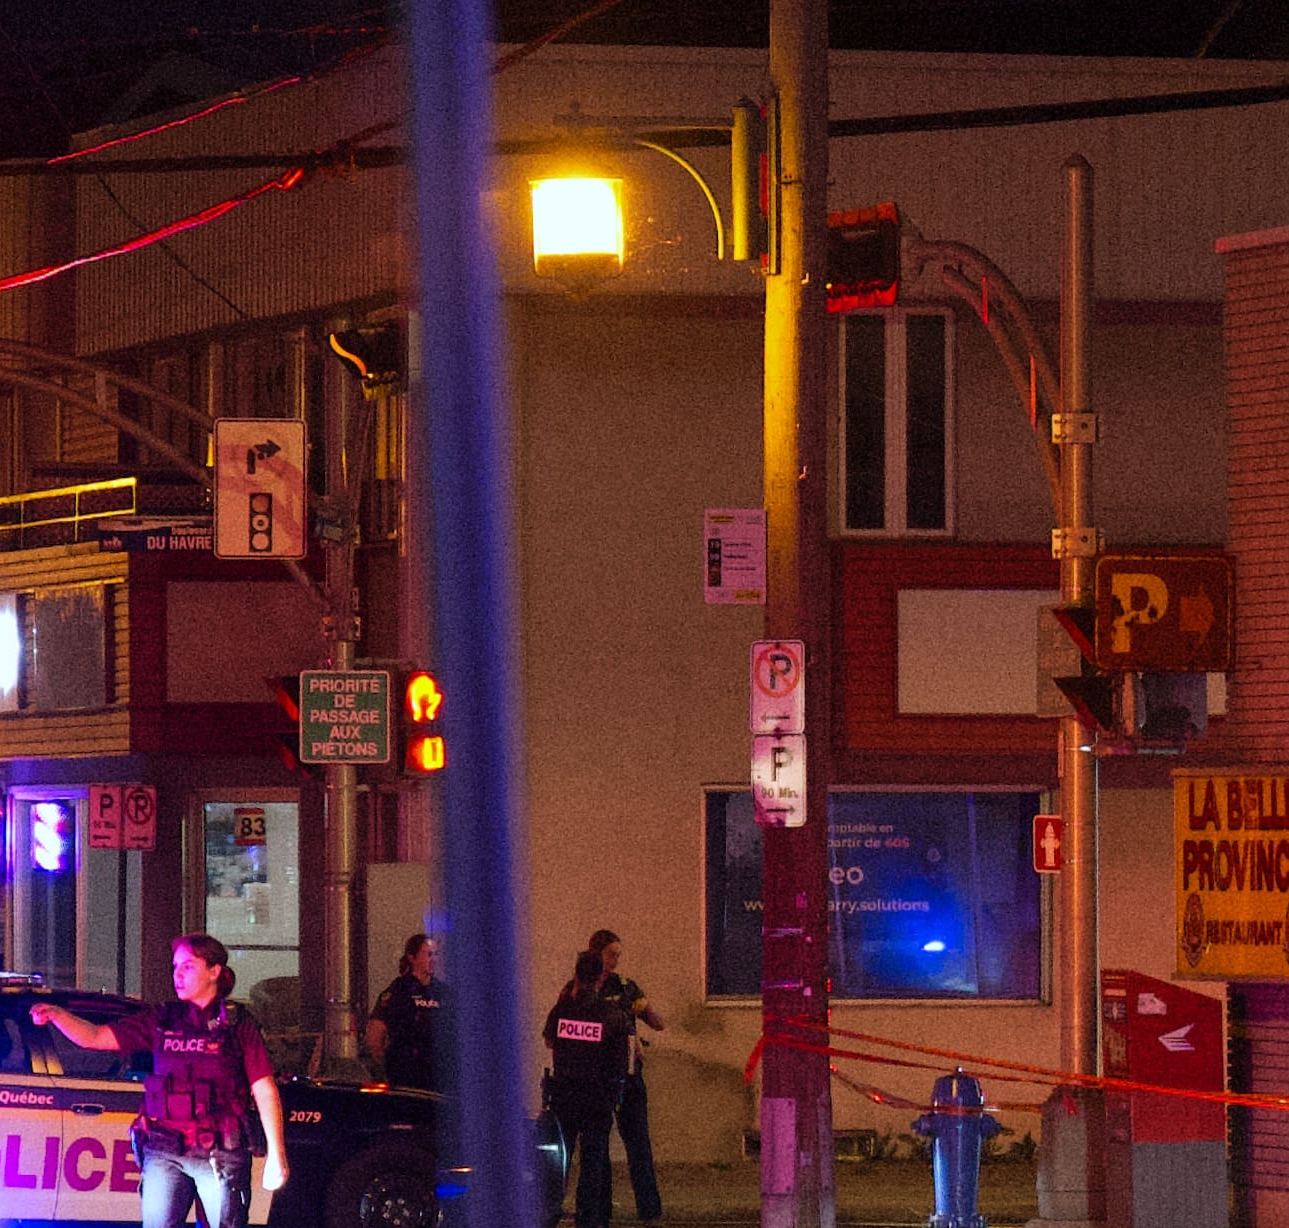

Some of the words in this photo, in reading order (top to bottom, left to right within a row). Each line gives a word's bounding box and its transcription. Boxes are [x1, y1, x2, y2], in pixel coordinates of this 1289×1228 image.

[146, 535, 166, 550] DU
[169, 535, 213, 550] HAVRE
[1112, 572, 1169, 654] P
[310, 677, 380, 693] PRIORITÉ
[334, 694, 356, 708] DE
[310, 709, 380, 724] PASSAGE
[330, 725, 362, 739] AUX
[312, 740, 378, 756] PIÉTONS
[771, 747, 794, 782] P
[100, 793, 114, 818] P
[1188, 779, 1222, 831] LA
[241, 817, 266, 837] 83
[864, 837, 881, 848] de
[559, 1022, 600, 1039] POLICE
[163, 1038, 205, 1052] POLICE
[289, 1110, 322, 1124] 2079
